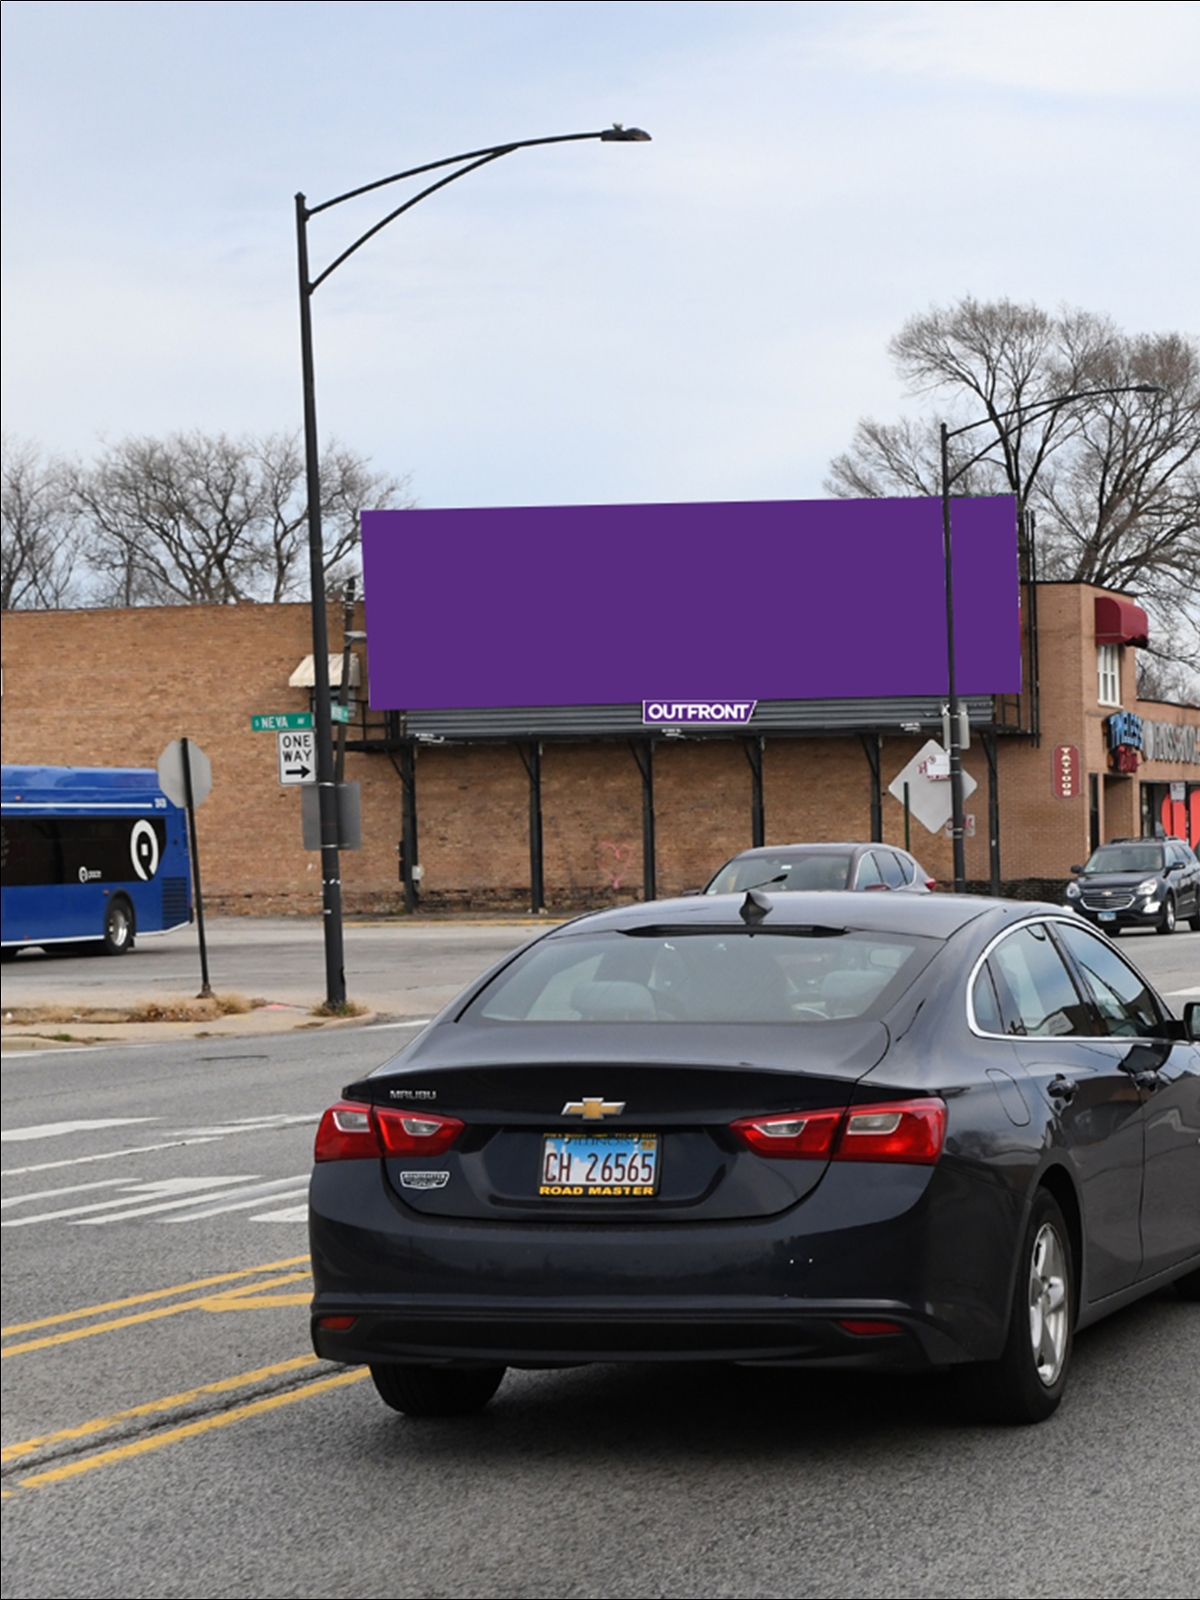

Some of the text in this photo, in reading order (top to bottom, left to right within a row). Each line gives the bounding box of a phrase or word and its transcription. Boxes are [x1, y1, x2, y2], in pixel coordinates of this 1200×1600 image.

[648, 704, 750, 719] OUTFRONT
[261, 716, 289, 729] NEVA
[282, 735, 311, 748] ONE
[282, 750, 312, 762] WAY
[1061, 747, 1072, 796] TATTOOS
[545, 1153, 655, 1182] CH 26565
[539, 1186, 655, 1196] ROAD MASTER
